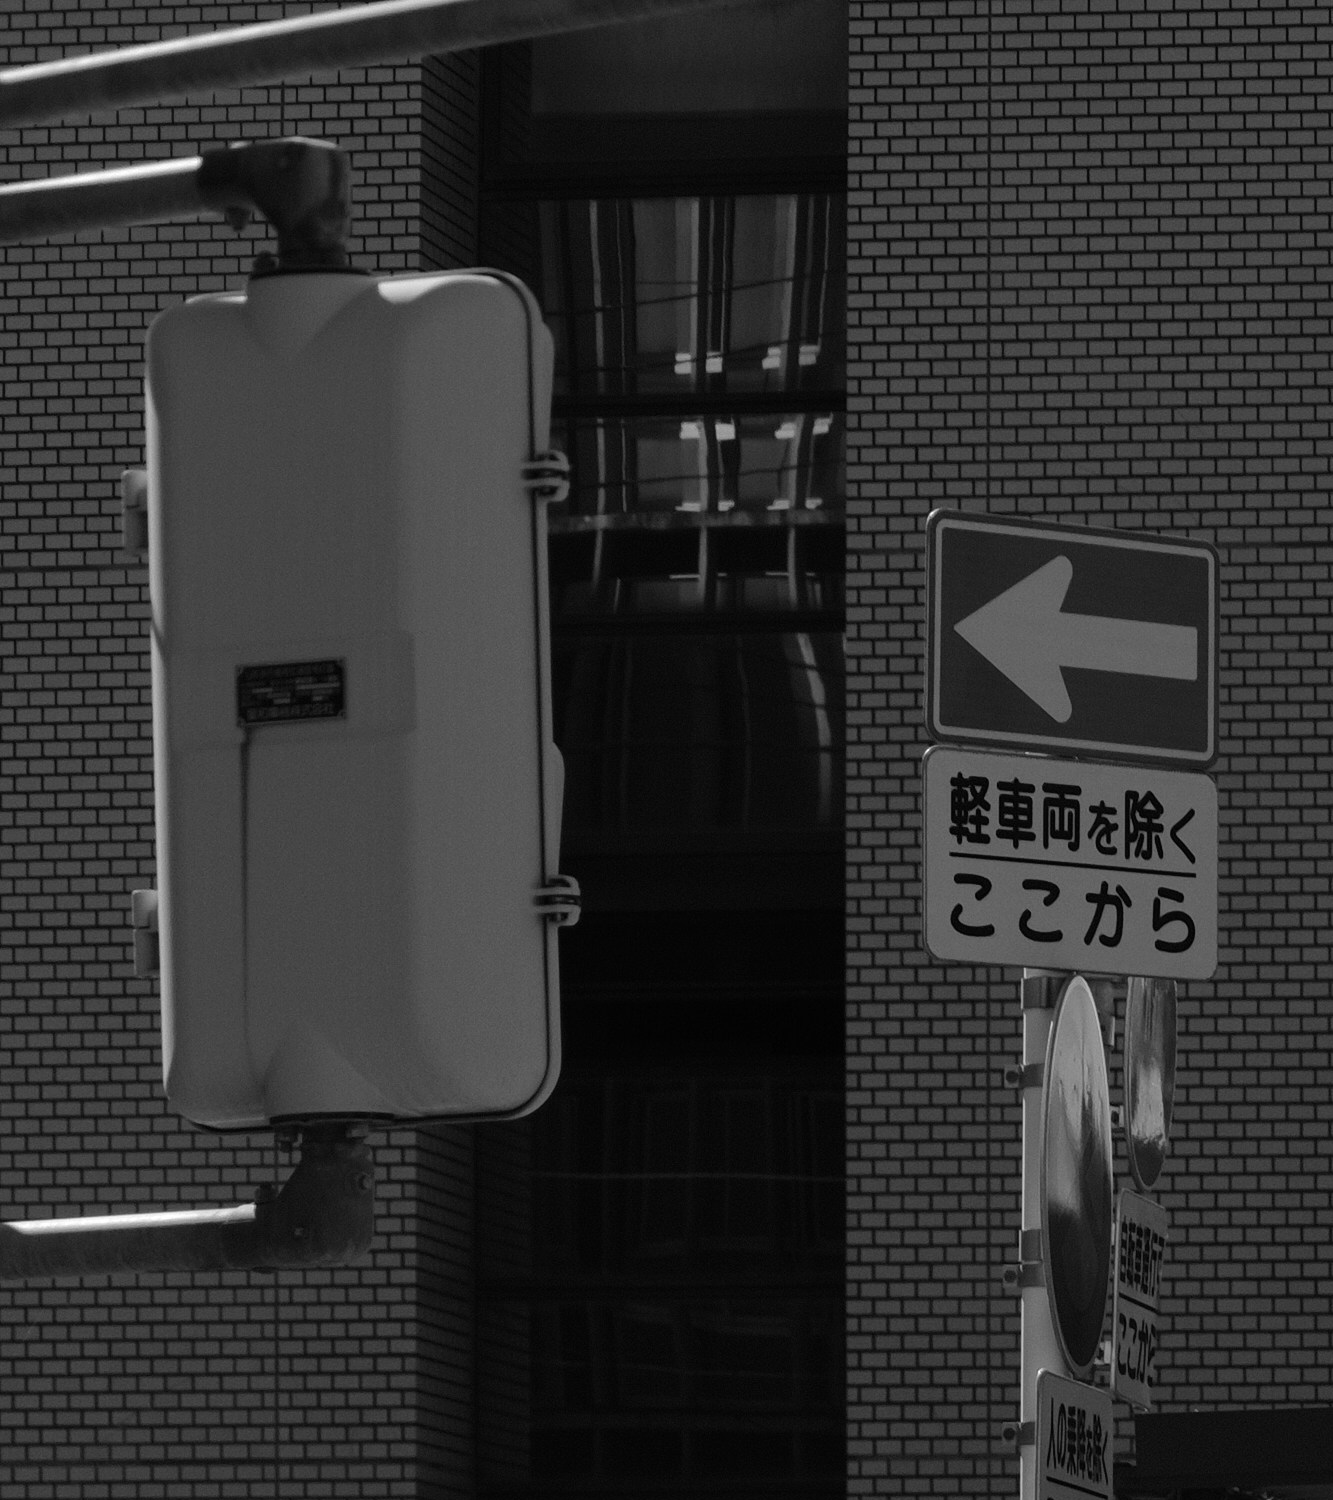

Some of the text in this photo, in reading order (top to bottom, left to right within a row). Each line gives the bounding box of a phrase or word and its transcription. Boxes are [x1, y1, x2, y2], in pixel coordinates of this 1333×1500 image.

[949, 771, 1197, 865] 軽車両を除く
[949, 872, 1197, 954] ここから
[1046, 1396, 1110, 1486] 人の乗降を除く
